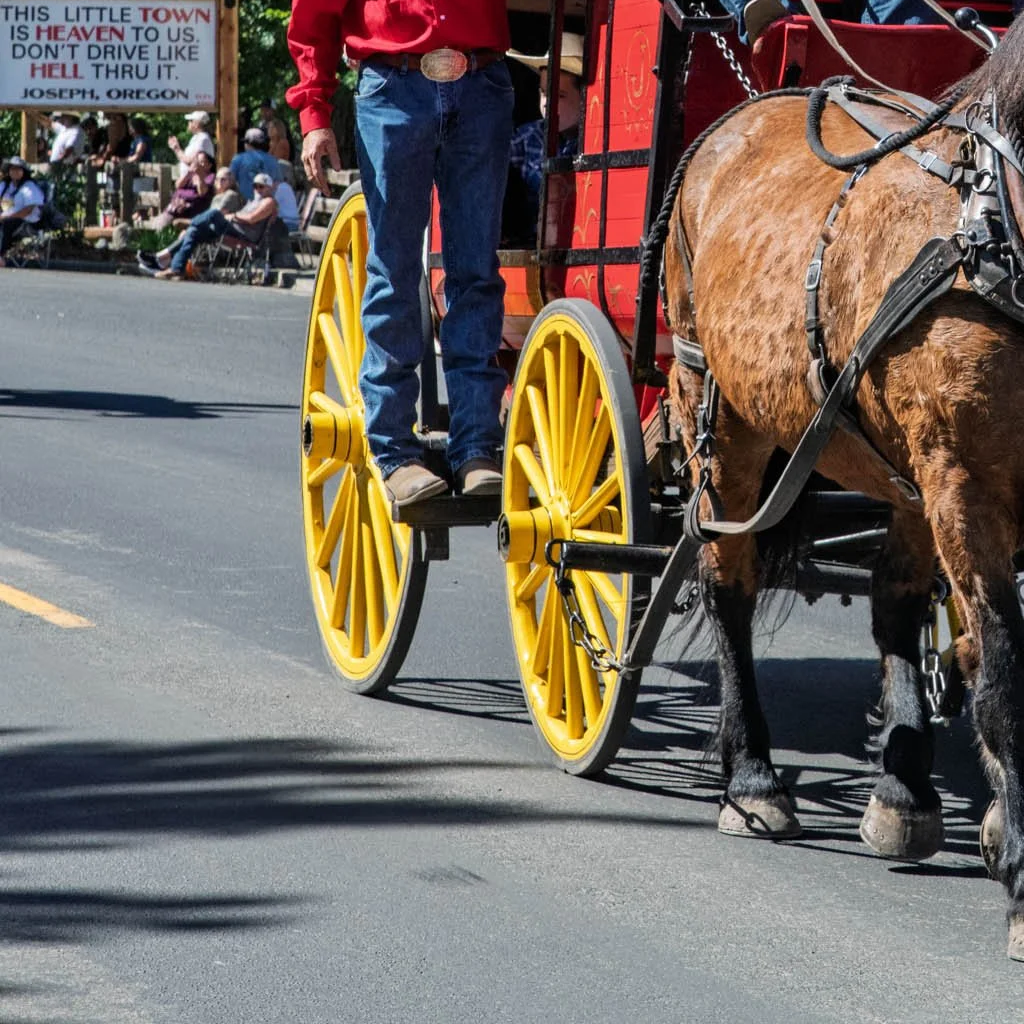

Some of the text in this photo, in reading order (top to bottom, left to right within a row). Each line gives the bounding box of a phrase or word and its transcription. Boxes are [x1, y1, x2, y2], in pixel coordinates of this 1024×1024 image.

[1, 5, 210, 24] THIS LITTLE TOWN
[10, 25, 199, 43] IS HEAVEN TO US.
[12, 43, 199, 61] DON'T DRIVE LIKE
[30, 63, 179, 80] HELL THRU IT.
[21, 88, 99, 100] JOSEPH,
[106, 88, 189, 100] OREGON
